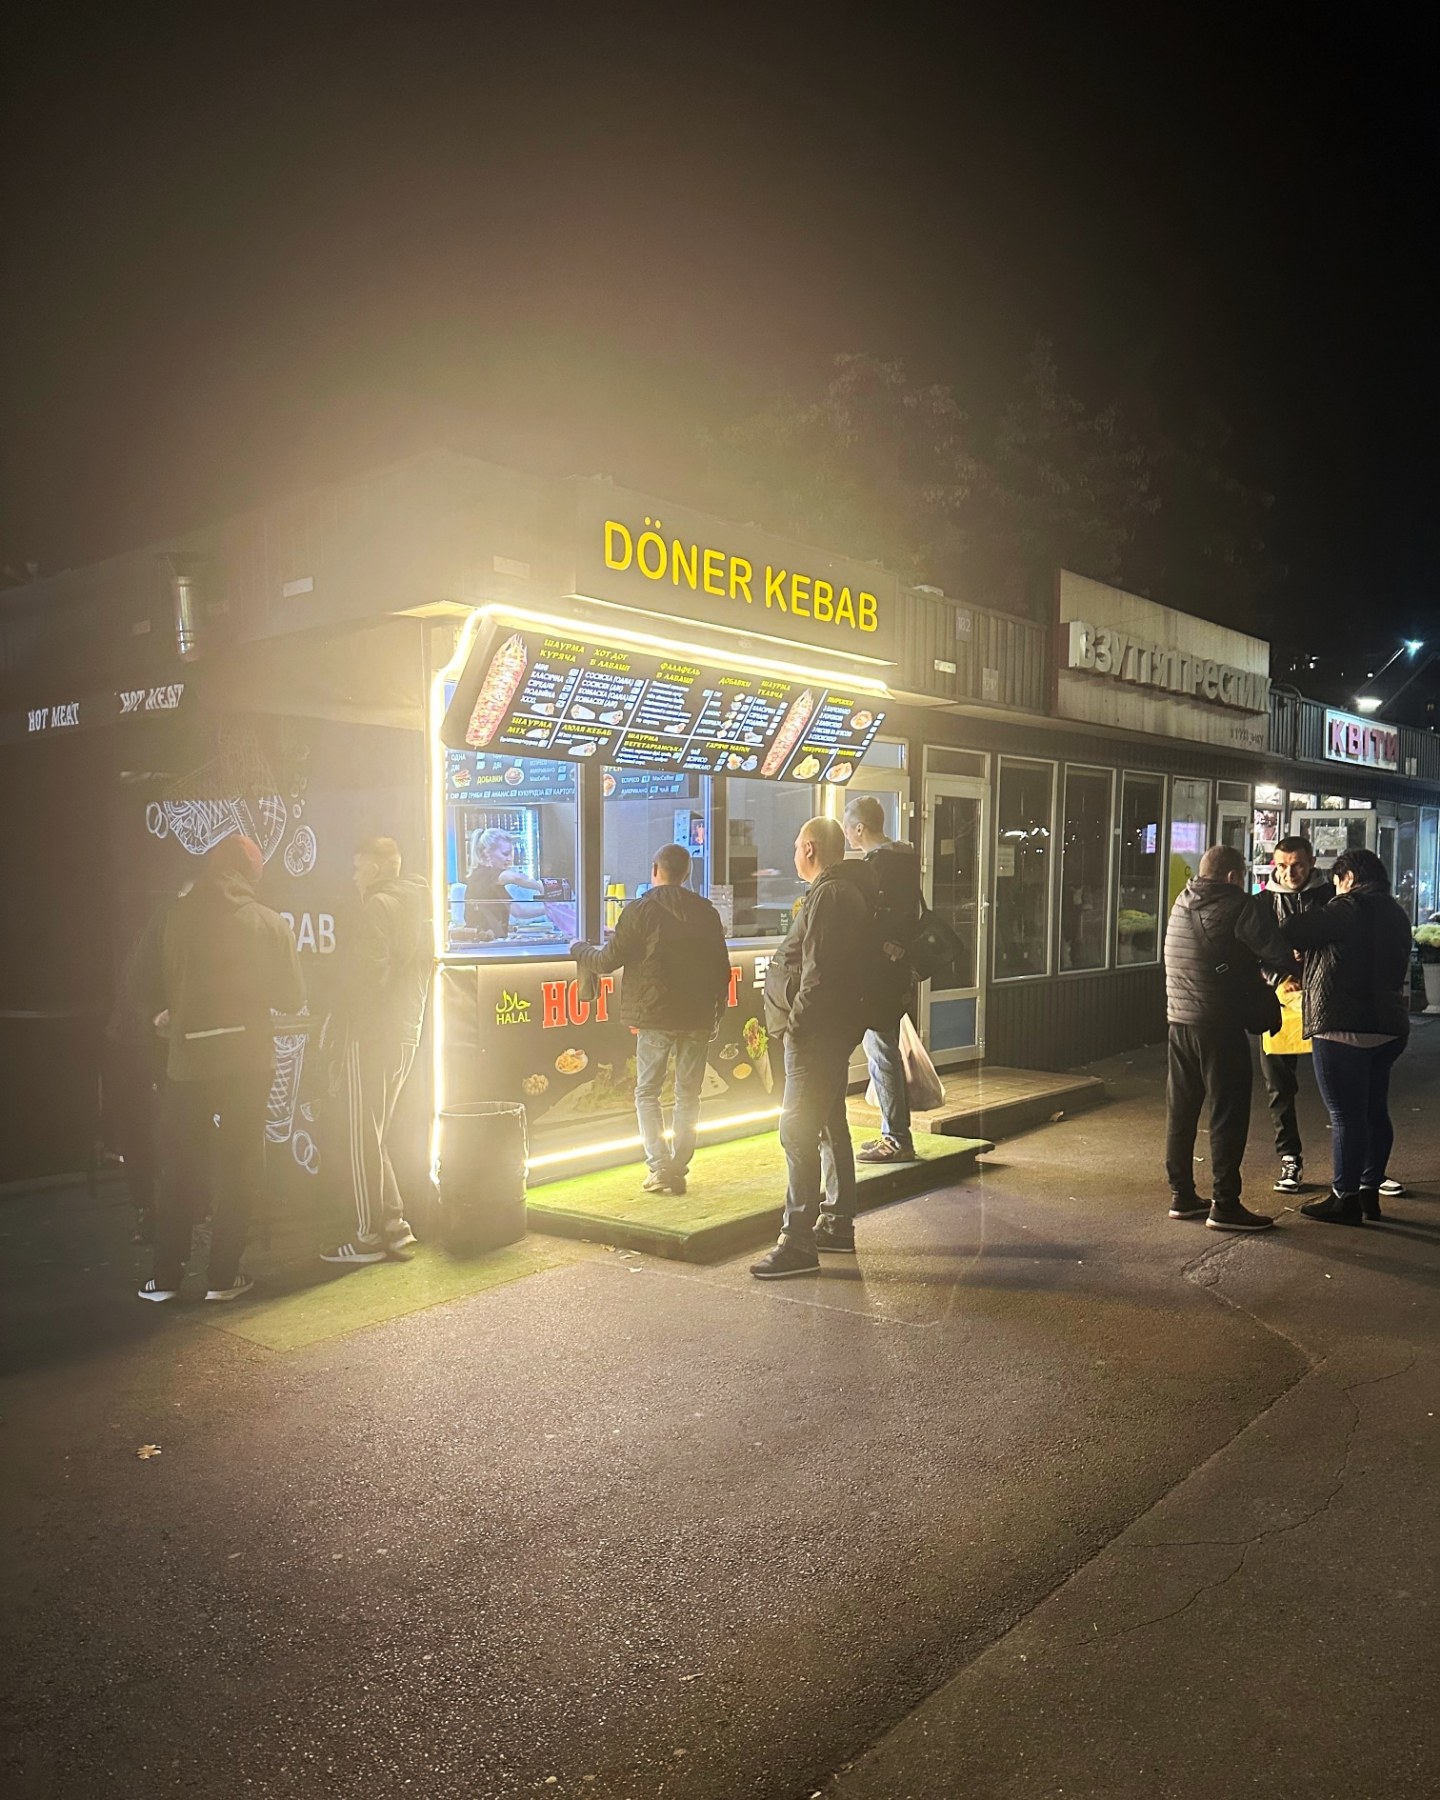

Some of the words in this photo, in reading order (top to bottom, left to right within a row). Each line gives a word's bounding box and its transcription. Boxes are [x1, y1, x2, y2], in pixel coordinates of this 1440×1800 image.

[604, 516, 753, 604] DÖNER
[765, 565, 878, 632] KEBAB
[544, 639, 585, 653] ШАУРМА
[540, 649, 576, 663] КУРЯЧА
[594, 648, 611, 658] ХОТ
[611, 652, 629, 661] ДОГ
[660, 663, 701, 676] ФАЛАФЕЛЬ
[119, 690, 145, 714] HOT
[145, 684, 184, 710] MEAT
[28, 708, 49, 732] HOT
[51, 702, 80, 728] MEAT
[512, 716, 553, 729] ШАУРМА
[1329, 719, 1398, 762] КВІТИ
[495, 989, 531, 1013] حلال
[496, 1011, 531, 1025] HALAL
